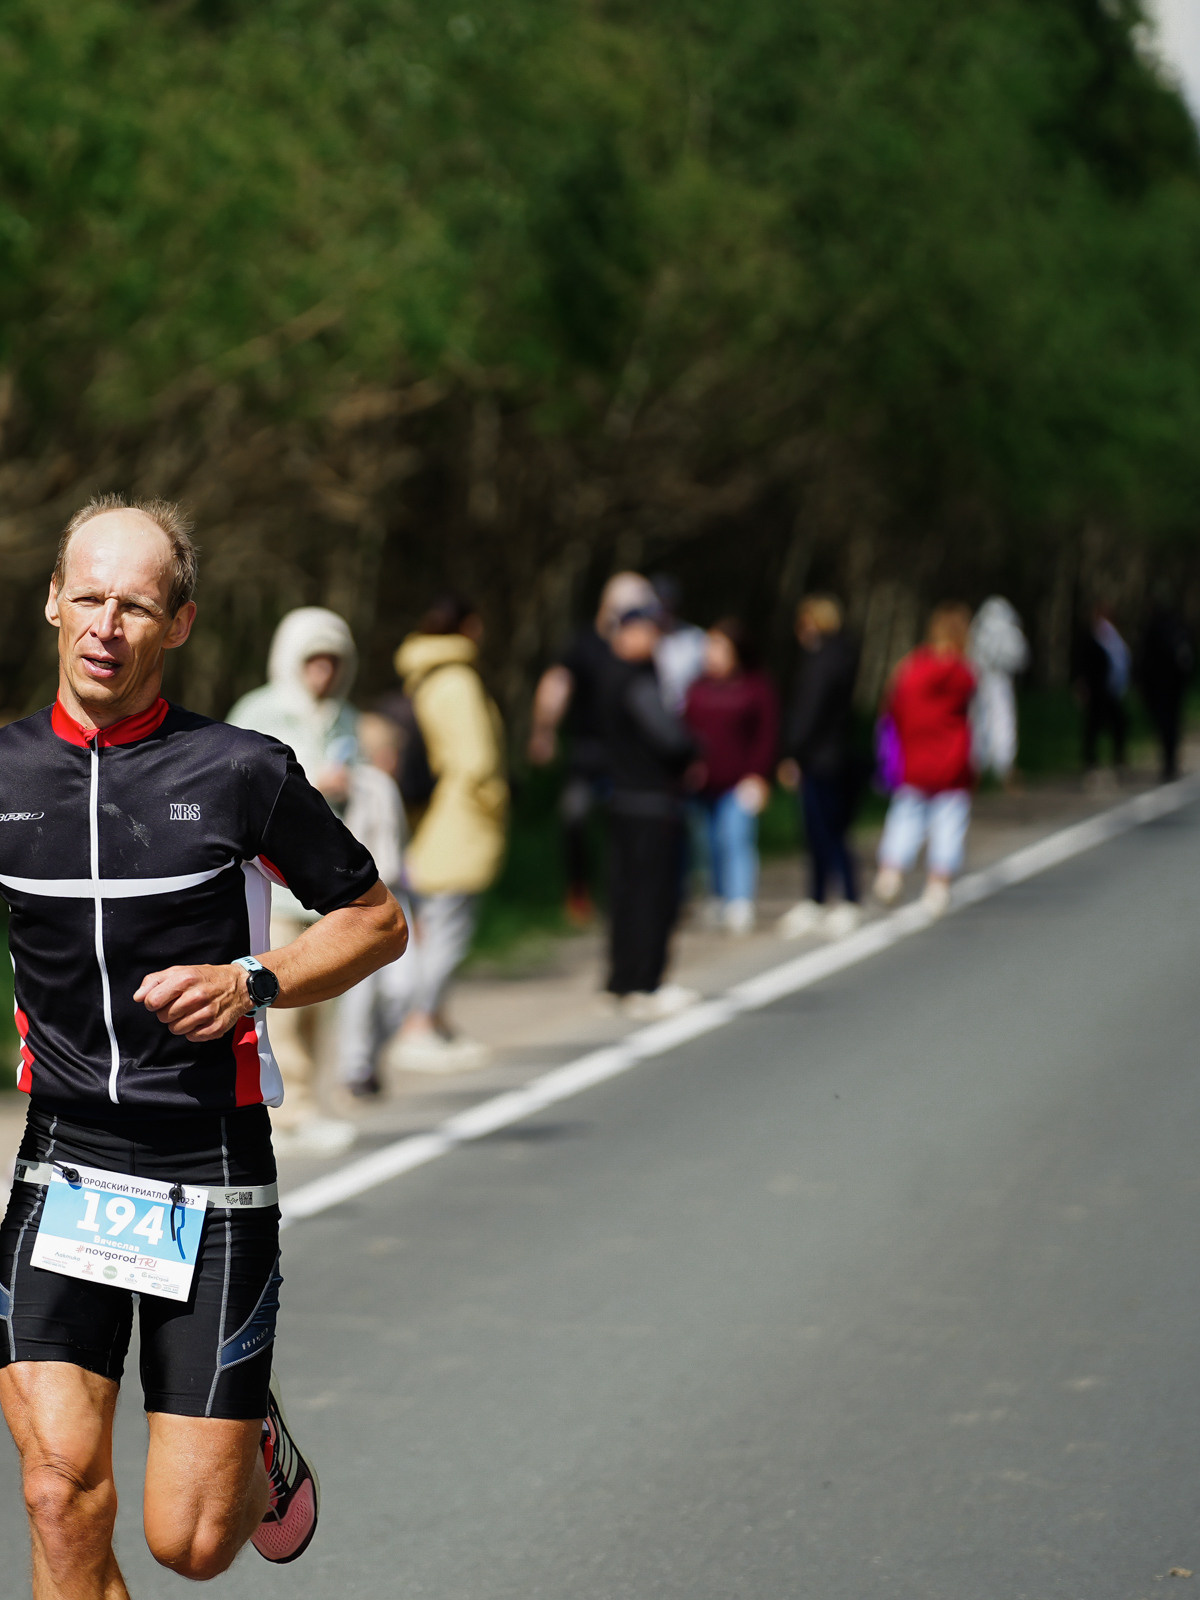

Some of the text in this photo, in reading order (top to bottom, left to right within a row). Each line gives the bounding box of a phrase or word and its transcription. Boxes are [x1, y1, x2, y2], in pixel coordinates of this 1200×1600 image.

[169, 803, 201, 821] XRS
[62, 1171, 129, 1193] ГОРОДСКИЙ
[178, 1196, 196, 1206] 023
[76, 1190, 165, 1246] 194
[93, 1234, 141, 1253] Вячеслав
